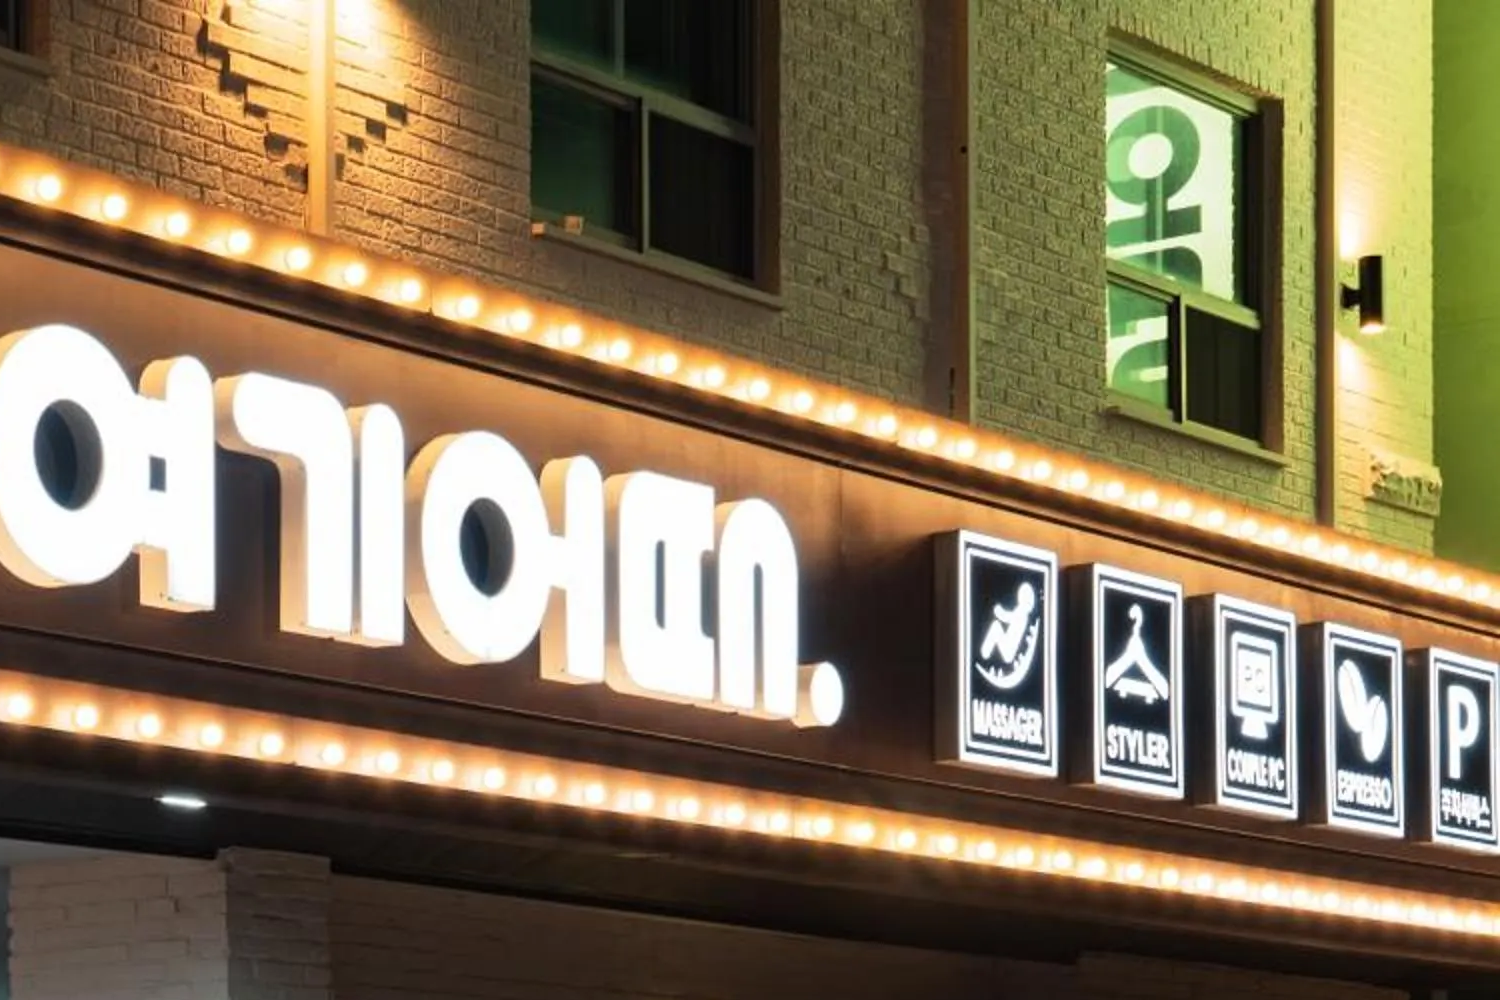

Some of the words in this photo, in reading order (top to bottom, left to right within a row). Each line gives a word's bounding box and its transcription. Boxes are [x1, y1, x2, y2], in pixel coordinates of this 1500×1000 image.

[972, 697, 1043, 747] MASSAGER
[1106, 723, 1171, 770] STYLER
[1337, 769, 1393, 809] ESPRESSO
